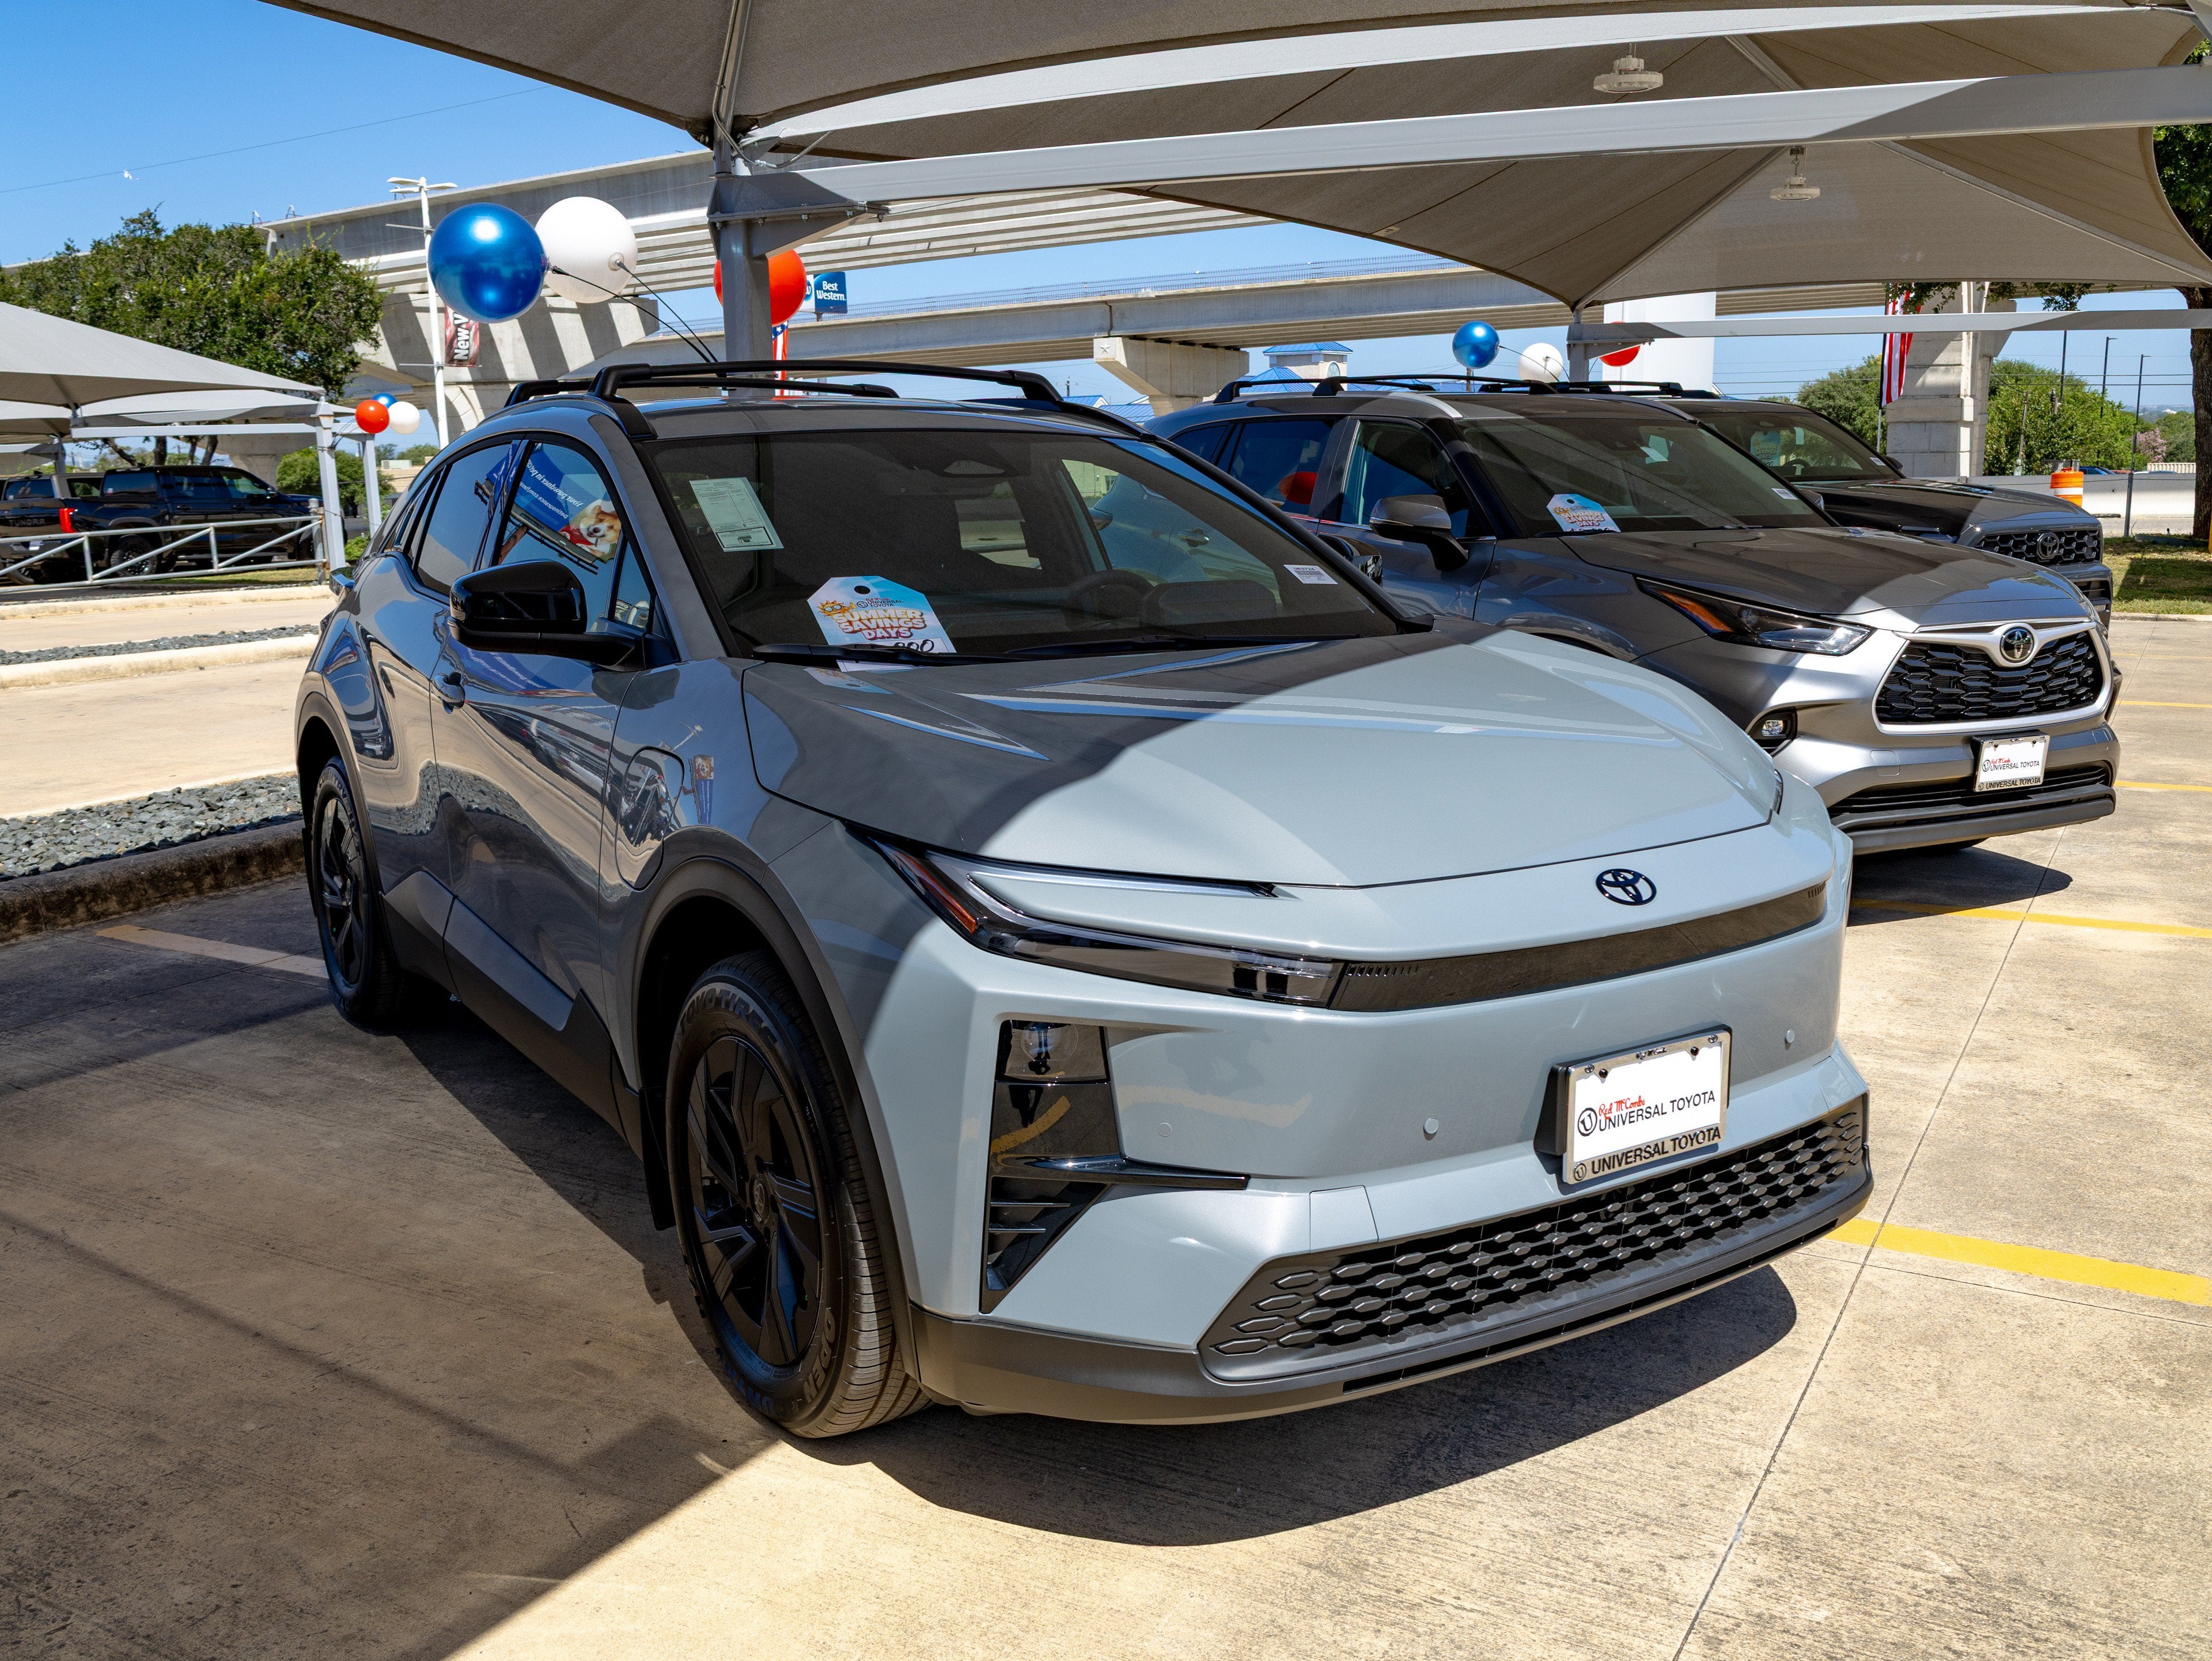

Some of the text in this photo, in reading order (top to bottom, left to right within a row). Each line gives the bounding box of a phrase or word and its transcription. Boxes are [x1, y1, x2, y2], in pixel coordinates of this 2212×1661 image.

[823, 281, 838, 291] Best
[816, 290, 845, 301] Western
[453, 327, 469, 360] New
[832, 609, 922, 623] SUMMER
[839, 618, 926, 633] SAVINGS
[862, 627, 912, 640] DAYS
[1990, 762, 2019, 771] UNIVERSAL
[1986, 777, 2041, 789] UNIVERSAL TOYOTA
[1599, 1095, 1645, 1118] Red McCombs
[1599, 1090, 1715, 1132] UNIVERSAL TOYOTA
[1592, 1126, 1721, 1174] UNIVERSAL TOYOTA
[804, 1309, 835, 1404] OPEN
